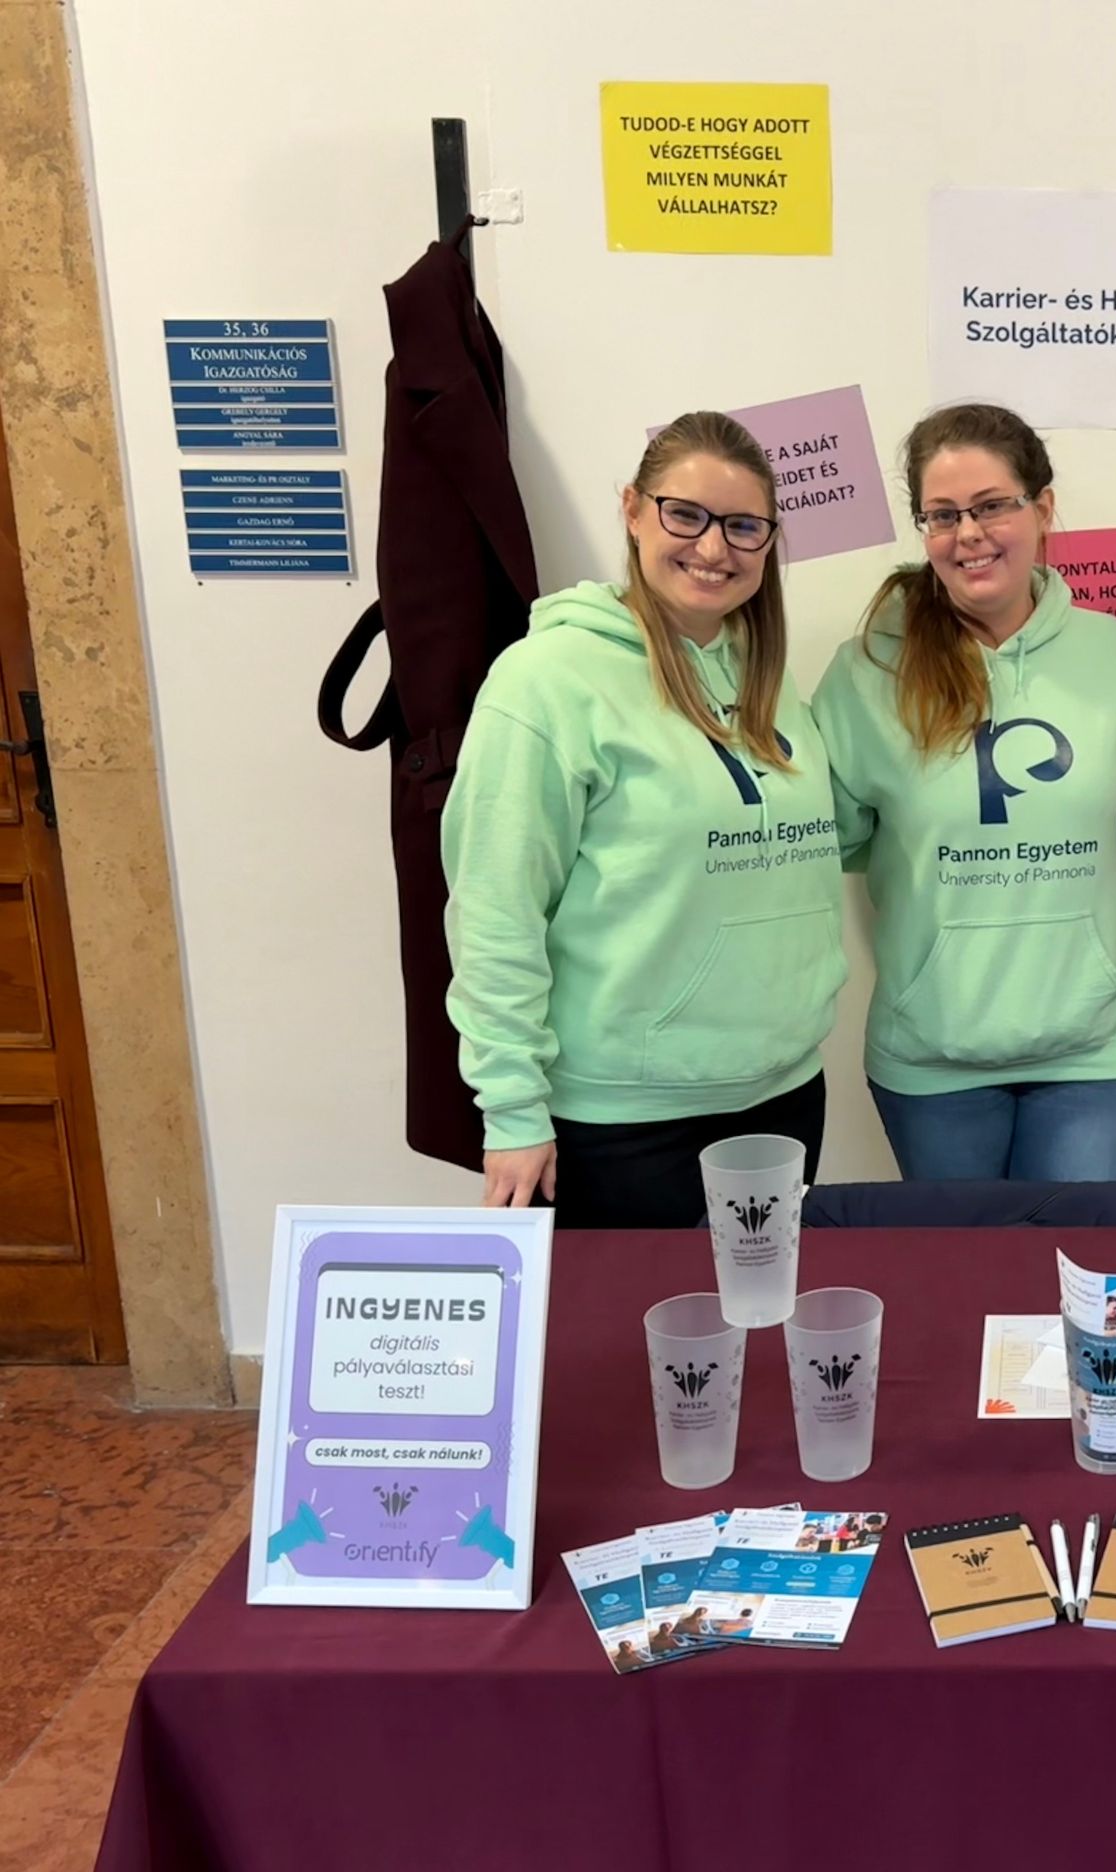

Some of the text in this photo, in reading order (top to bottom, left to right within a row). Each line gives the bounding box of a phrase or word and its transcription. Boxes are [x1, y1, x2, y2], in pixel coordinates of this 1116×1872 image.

[620, 116, 810, 134] TUDOD-E HOGY ADOTT
[649, 140, 783, 161] VÉGZETTSÉGGEL
[646, 170, 788, 188] MILYEN MUNKÁT
[657, 195, 778, 216] VÁLLALHATSZ?
[962, 286, 1058, 310] Karrier-
[1064, 288, 1093, 311] és
[223, 322, 269, 338] 35, 36
[778, 446, 790, 460] A
[792, 433, 839, 458] SAJÁT
[820, 460, 839, 478] ÉS
[705, 853, 773, 874] University
[775, 850, 788, 866] of
[938, 840, 1098, 863] Pannon Egyetem
[939, 870, 1011, 887] University
[1014, 868, 1029, 884] of
[325, 1297, 486, 1321] INGYENES
[369, 1334, 440, 1355] digitális
[332, 1358, 474, 1380] pályaválasztási
[378, 1383, 425, 1400] teszt!
[315, 1446, 483, 1461] csak most, csak nálunk!
